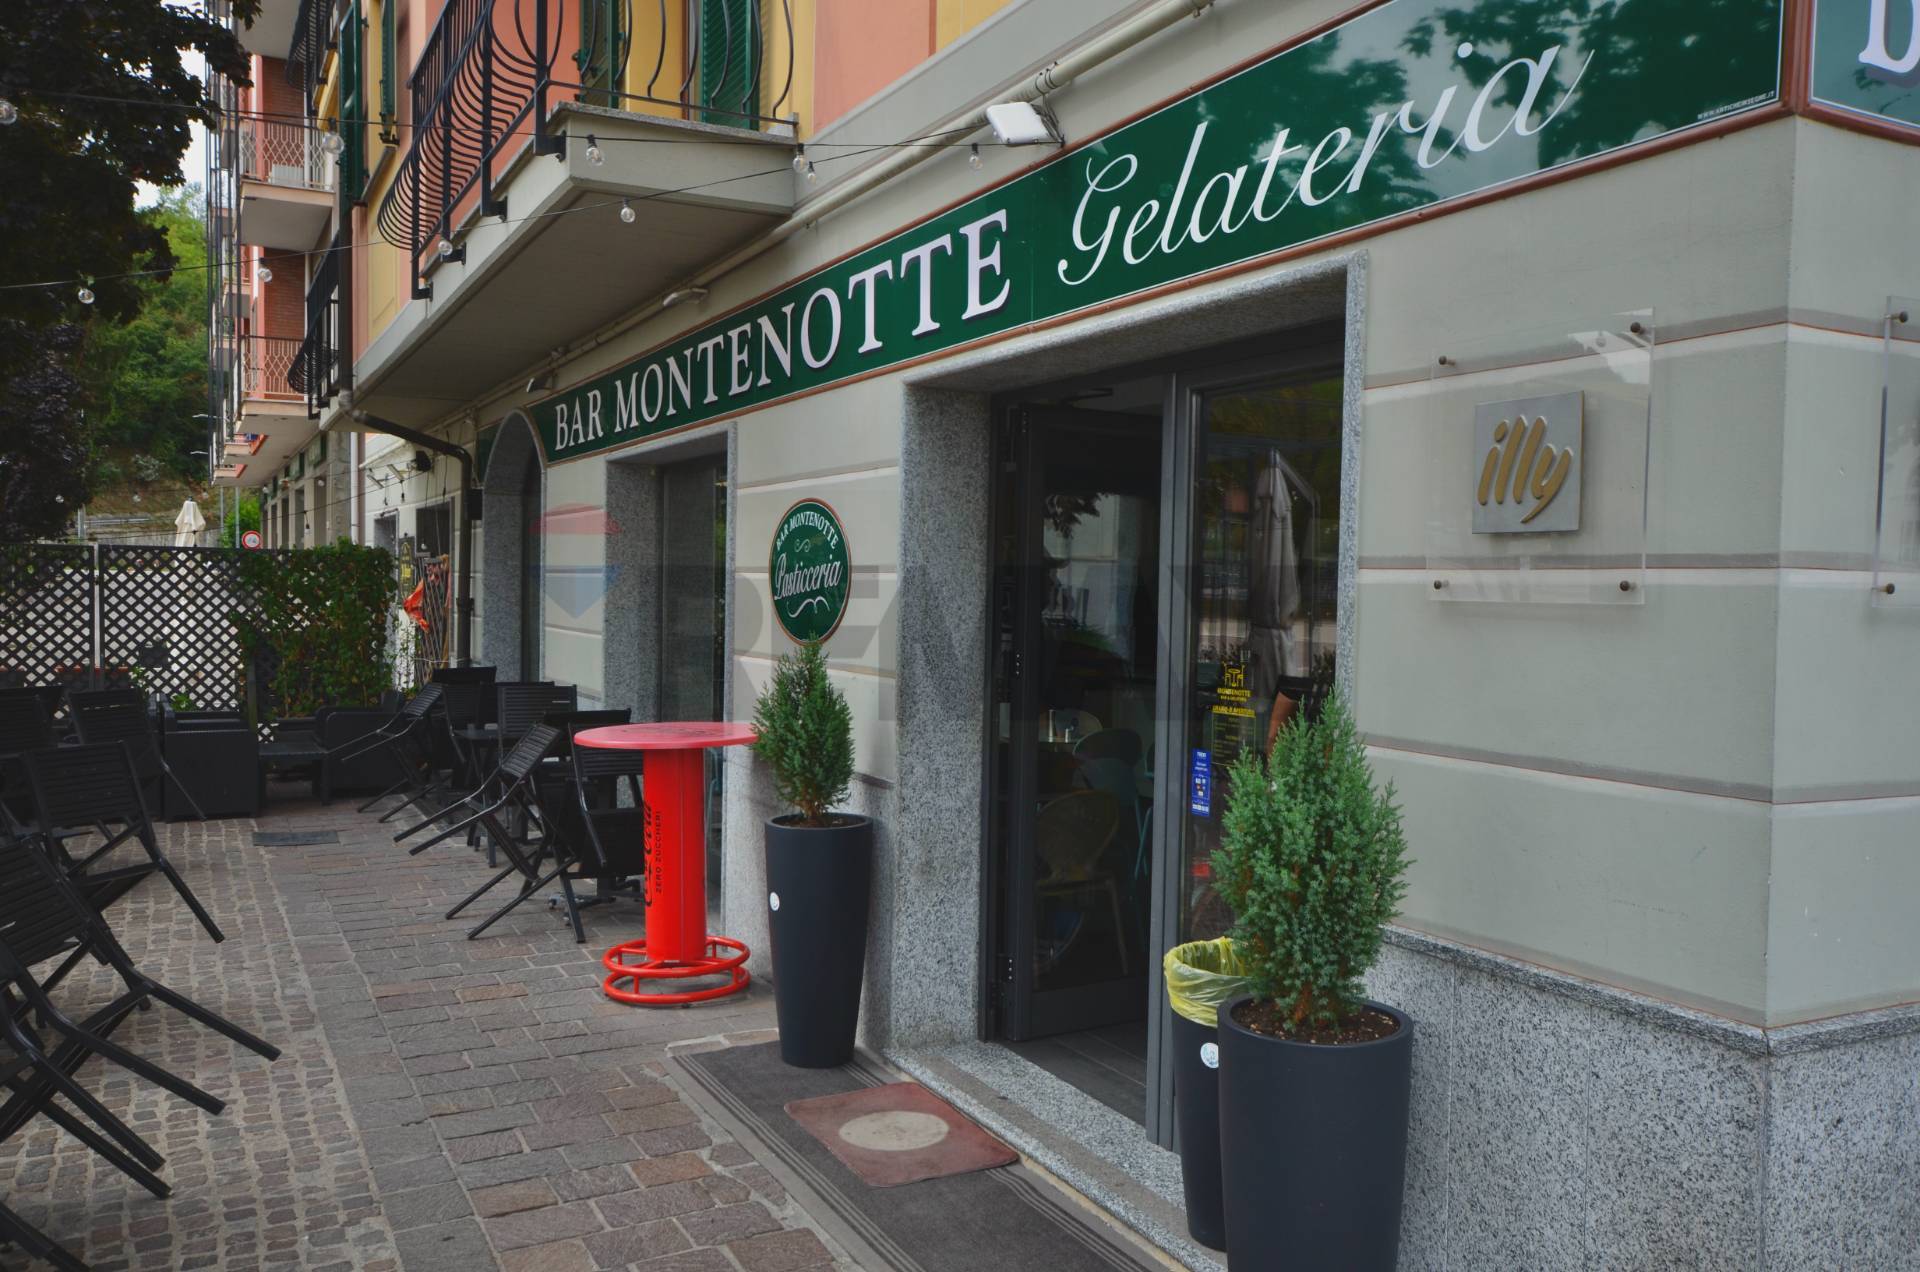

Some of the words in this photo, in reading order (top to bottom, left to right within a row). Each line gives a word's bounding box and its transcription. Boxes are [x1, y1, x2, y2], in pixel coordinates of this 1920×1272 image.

[1057, 43, 1594, 286] Gelateria
[554, 388, 604, 451] BAR
[613, 208, 1011, 434] MONTENOTTE
[1477, 413, 1574, 525] illy
[776, 525, 789, 551] BAR
[789, 511, 839, 549] MONTENOTTE
[774, 552, 843, 600] Pasticceria
[655, 811, 663, 863] ZUCCHERI
[655, 866, 663, 894] ZERO
